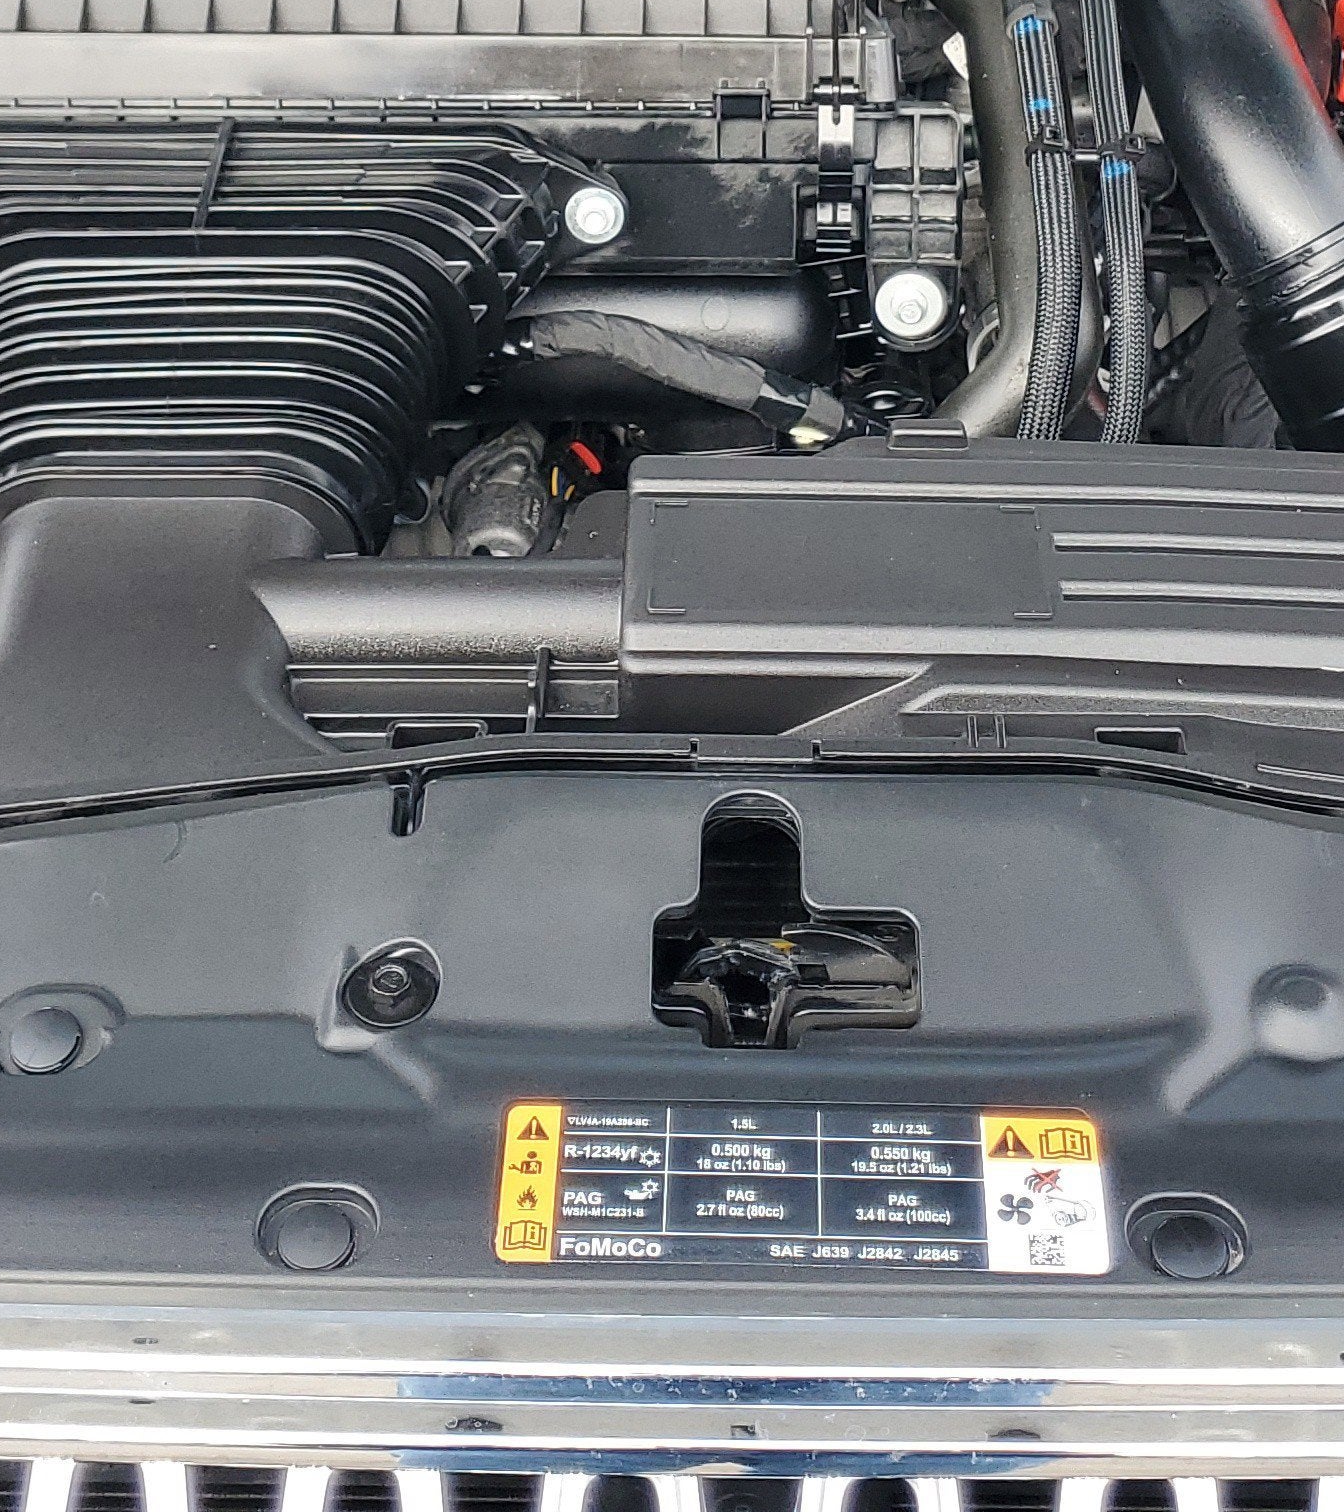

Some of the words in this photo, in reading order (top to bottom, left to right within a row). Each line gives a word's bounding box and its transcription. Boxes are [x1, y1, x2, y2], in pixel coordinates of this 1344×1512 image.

[731, 1118, 758, 1130] 1.5L
[872, 1123, 898, 1135] 2.0L
[905, 1124, 933, 1136] 2.3L
[564, 1143, 639, 1162] R-1234yf
[711, 1143, 750, 1157] 0.500
[753, 1144, 771, 1160] kg
[870, 1146, 909, 1160] 0.550
[912, 1147, 931, 1163] kg
[697, 1157, 711, 1170] 18
[714, 1161, 729, 1170] oz
[763, 1159, 786, 1173] lbs)
[879, 1164, 895, 1174] oz
[896, 1161, 925, 1175] (1.21
[928, 1162, 952, 1176] lbs)
[563, 1191, 603, 1205] PAG
[726, 1189, 755, 1202] PAG
[888, 1194, 918, 1207] PAG
[696, 1203, 716, 1216] 2.7
[717, 1203, 727, 1216] fl
[728, 1207, 745, 1217] oz
[746, 1204, 784, 1220] (80cc)
[855, 1208, 875, 1221] 3.4
[877, 1209, 886, 1221] fl
[888, 1212, 904, 1222] oz
[906, 1209, 951, 1226] (100cc)
[559, 1237, 662, 1258] FoMoCo
[769, 1244, 806, 1258] SAE
[811, 1245, 850, 1259] J639
[857, 1246, 903, 1260] J2842
[913, 1247, 960, 1261] J2845
